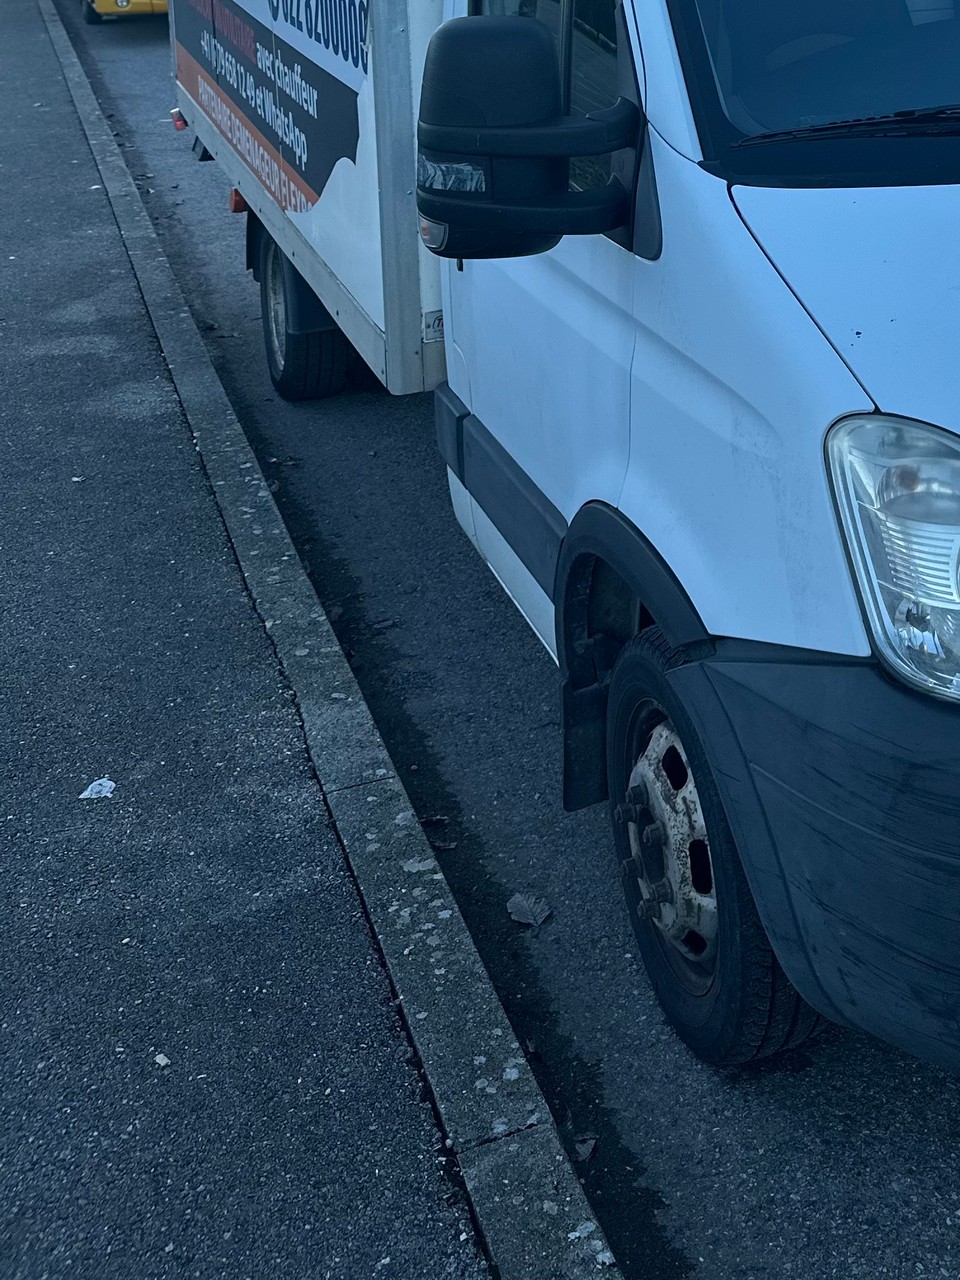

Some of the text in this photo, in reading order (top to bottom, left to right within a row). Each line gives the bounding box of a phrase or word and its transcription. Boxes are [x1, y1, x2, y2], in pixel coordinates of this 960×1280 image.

[256, 42, 318, 119] avec chauffeur
[255, 86, 265, 119] et
[262, 86, 308, 171] WhatsApp
